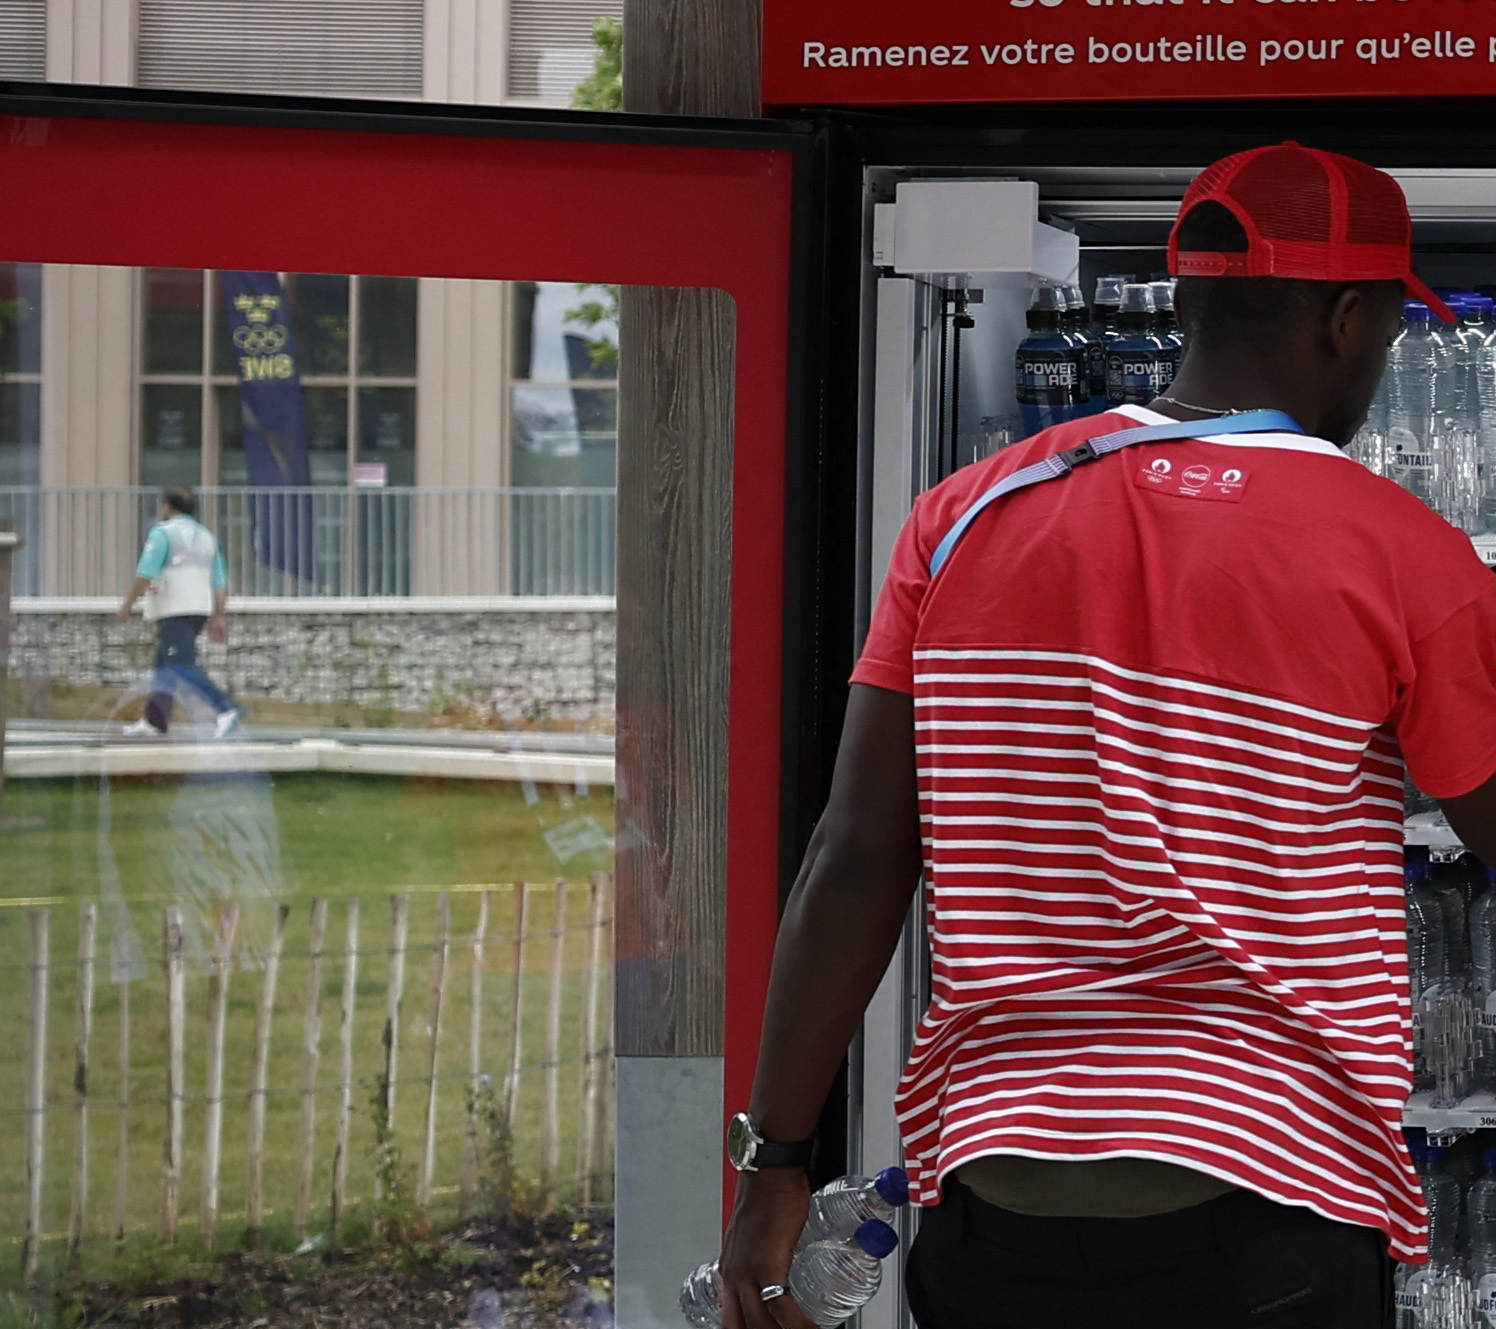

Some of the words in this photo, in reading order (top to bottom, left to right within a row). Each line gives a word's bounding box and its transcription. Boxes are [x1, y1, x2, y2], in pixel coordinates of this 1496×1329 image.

[803, 41, 969, 68] Ramenez
[980, 38, 1075, 65] votre
[1088, 34, 1247, 64] bouteille
[1260, 39, 1344, 67] pour
[1024, 362, 1077, 375] POWER
[1124, 362, 1173, 375] POWER
[1048, 374, 1078, 386] ADE
